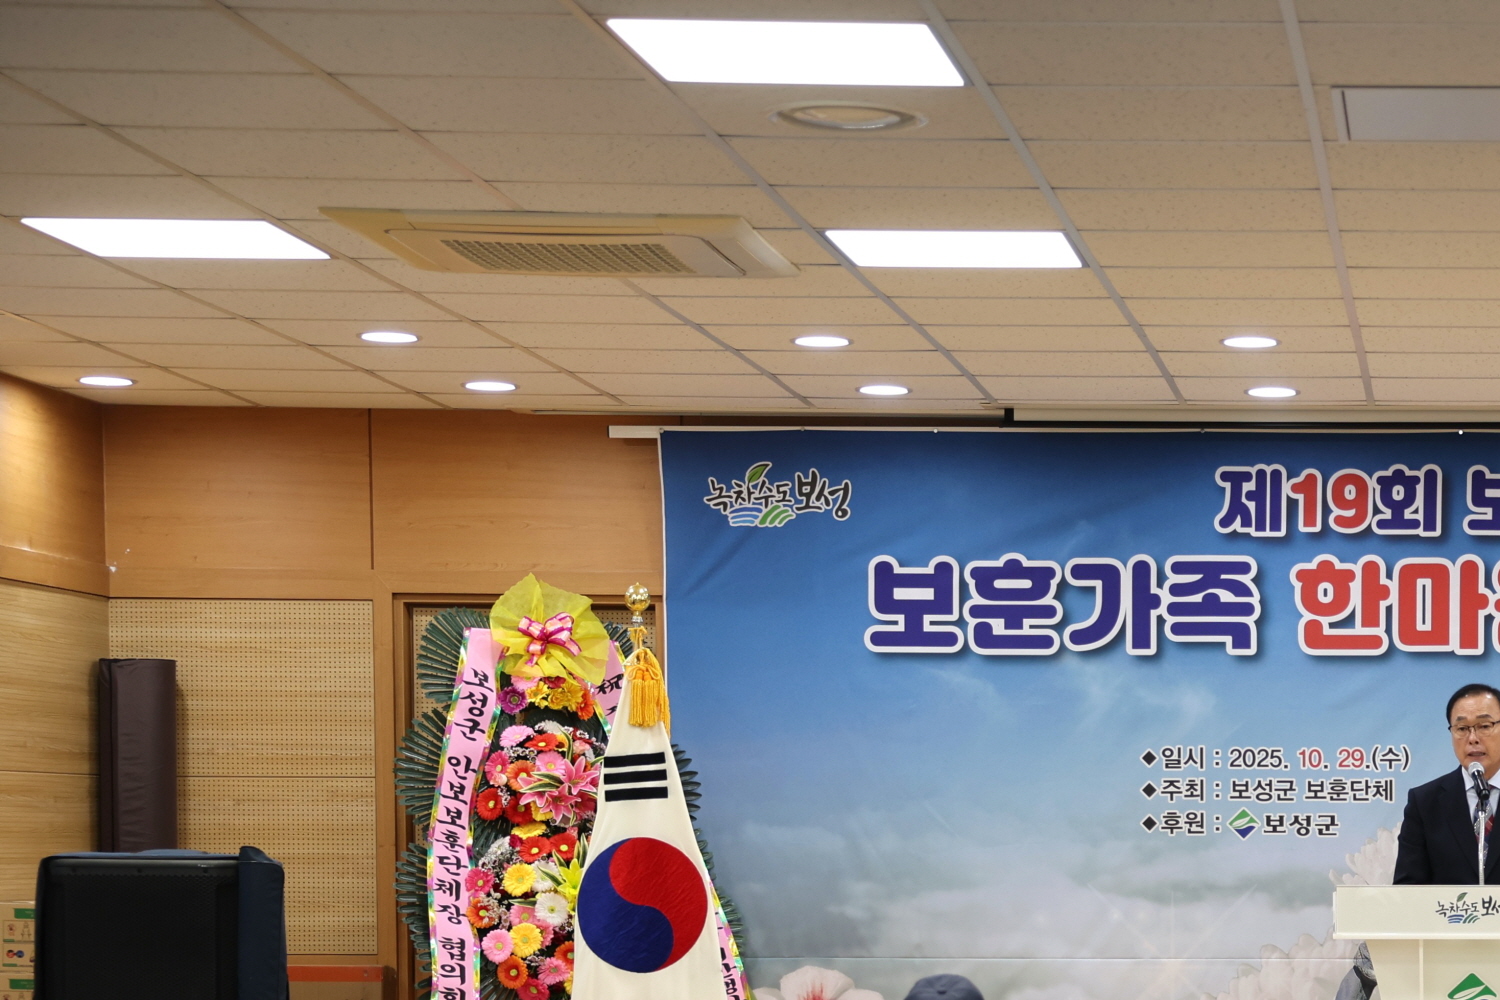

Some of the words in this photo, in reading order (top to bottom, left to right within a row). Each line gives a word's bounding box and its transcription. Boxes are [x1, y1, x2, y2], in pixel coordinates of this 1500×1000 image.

[704, 476, 795, 513] 녹차수도
[794, 468, 851, 521] 보성
[1215, 464, 1443, 537] 제19회
[864, 552, 1262, 656] 보훈가족
[456, 668, 493, 742] 보성군
[1161, 747, 1204, 769] 일시
[1228, 749, 1290, 770] 2025.
[1299, 749, 1330, 770] 10.
[1337, 746, 1410, 771] 29.(수)
[1160, 779, 1205, 801] 주최
[1229, 779, 1297, 802] 보성군
[1304, 779, 1395, 802] 보훈단체
[433, 755, 477, 925] 안보보훈단체장
[1160, 812, 1205, 835] 후원
[1263, 814, 1340, 836] 보성군
[1435, 900, 1479, 917] 녹차수도
